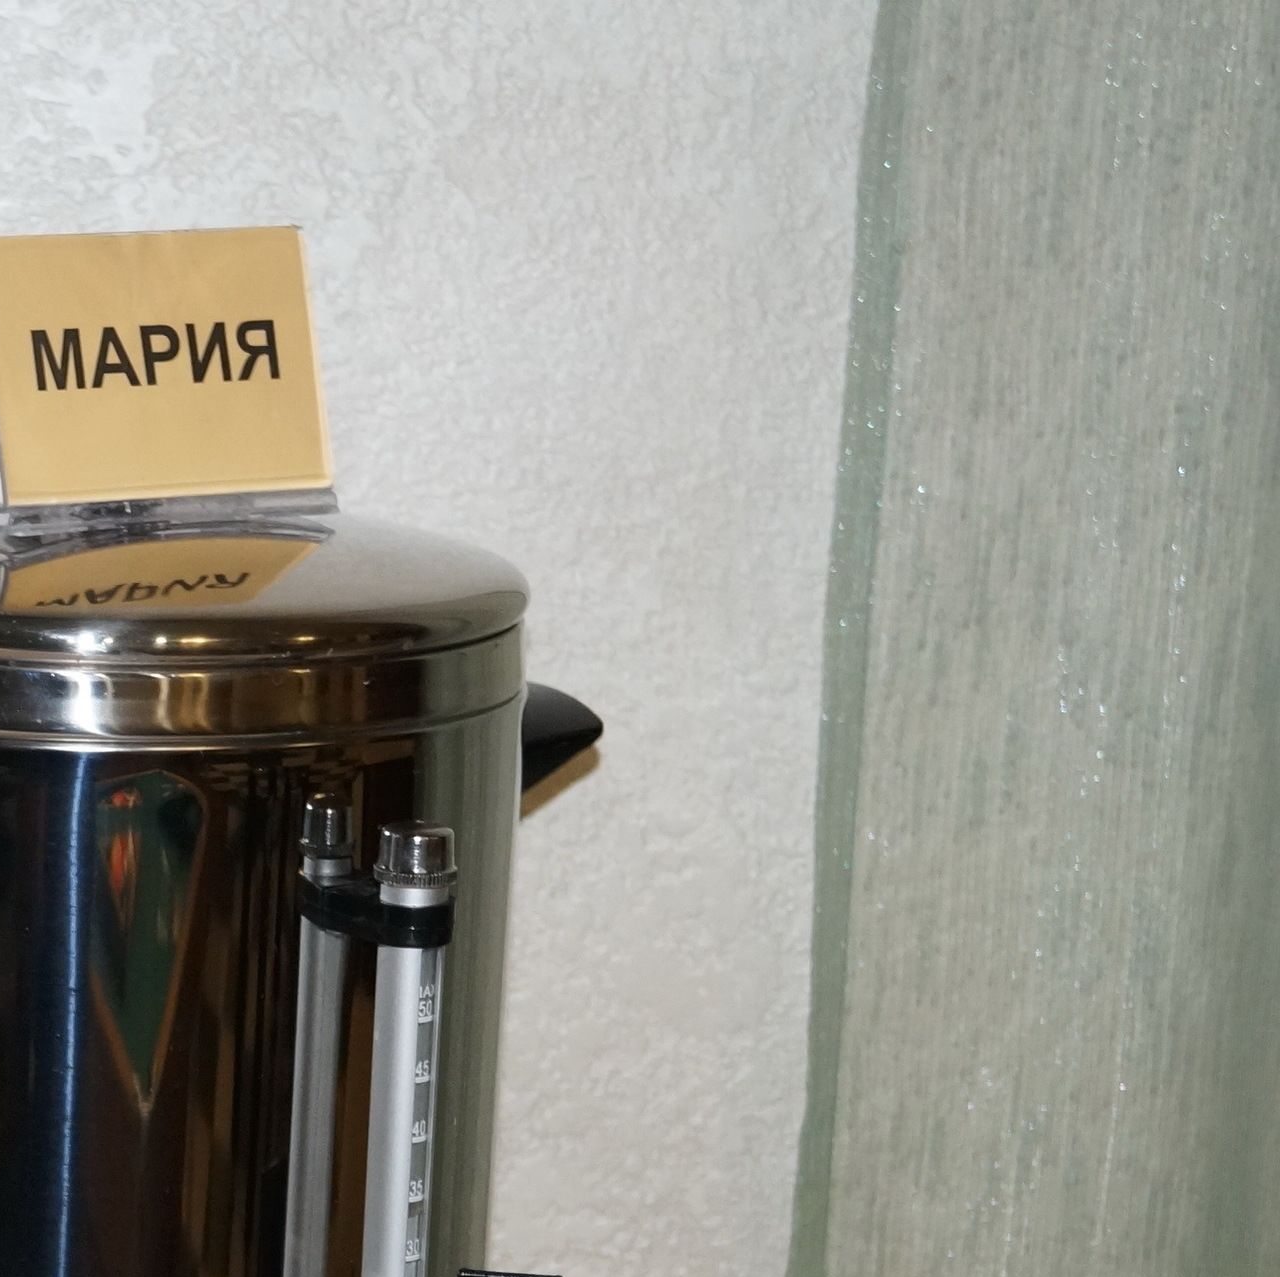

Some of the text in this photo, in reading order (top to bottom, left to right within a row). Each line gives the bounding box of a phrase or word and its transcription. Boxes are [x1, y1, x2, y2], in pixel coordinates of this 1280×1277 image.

[31, 319, 281, 391] МАРИЯ
[418, 999, 433, 1017] 50
[415, 1060, 430, 1077] 45
[412, 1120, 427, 1137] 40
[409, 1180, 423, 1197] 35
[406, 1240, 420, 1256] 30
